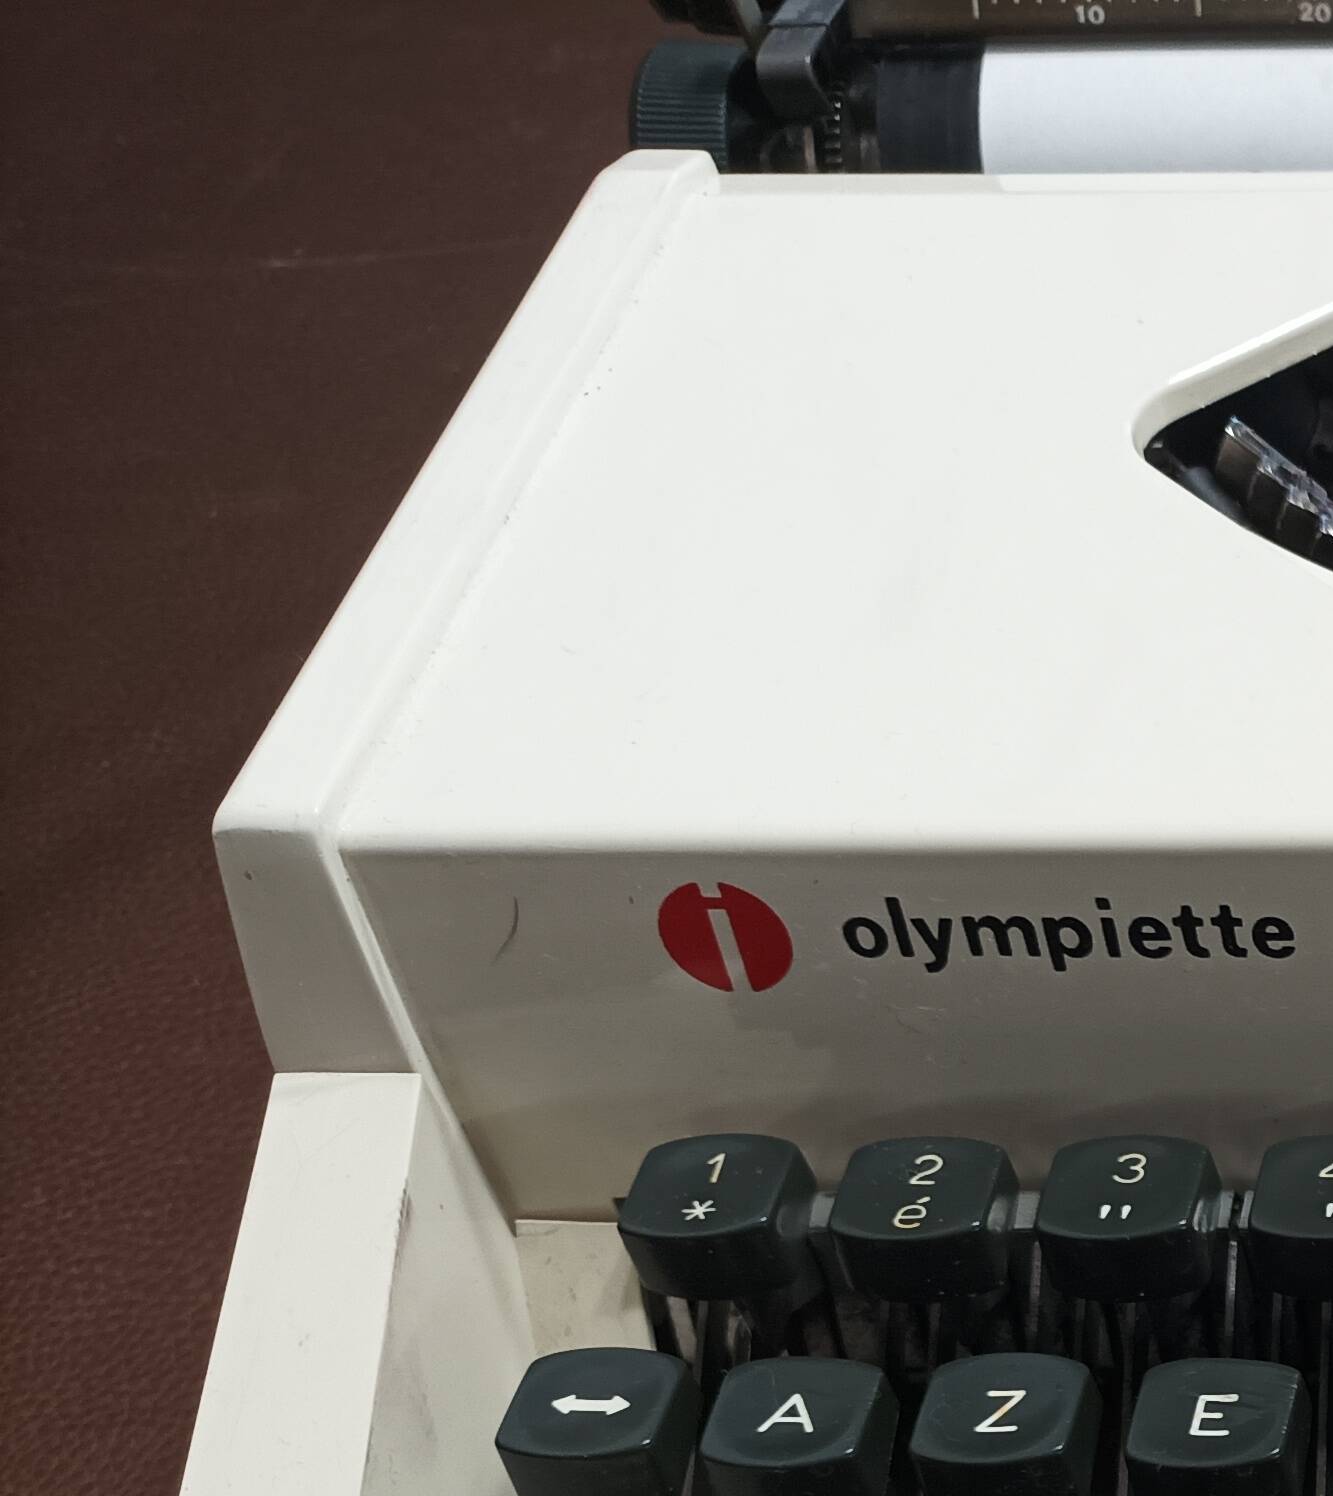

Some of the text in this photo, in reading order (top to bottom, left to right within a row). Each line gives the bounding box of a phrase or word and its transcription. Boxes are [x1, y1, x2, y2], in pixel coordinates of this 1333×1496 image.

[1074, 3, 1107, 26] 10
[1296, 0, 1333, 24] 20
[841, 895, 1297, 975] olympiette
[706, 1152, 727, 1184] 1
[908, 1153, 945, 1186] 2
[1111, 1152, 1148, 1185] 3
[892, 1195, 932, 1230] é
[756, 1392, 815, 1434] A
[973, 1388, 1028, 1434] Z
[1188, 1392, 1240, 1438] E
